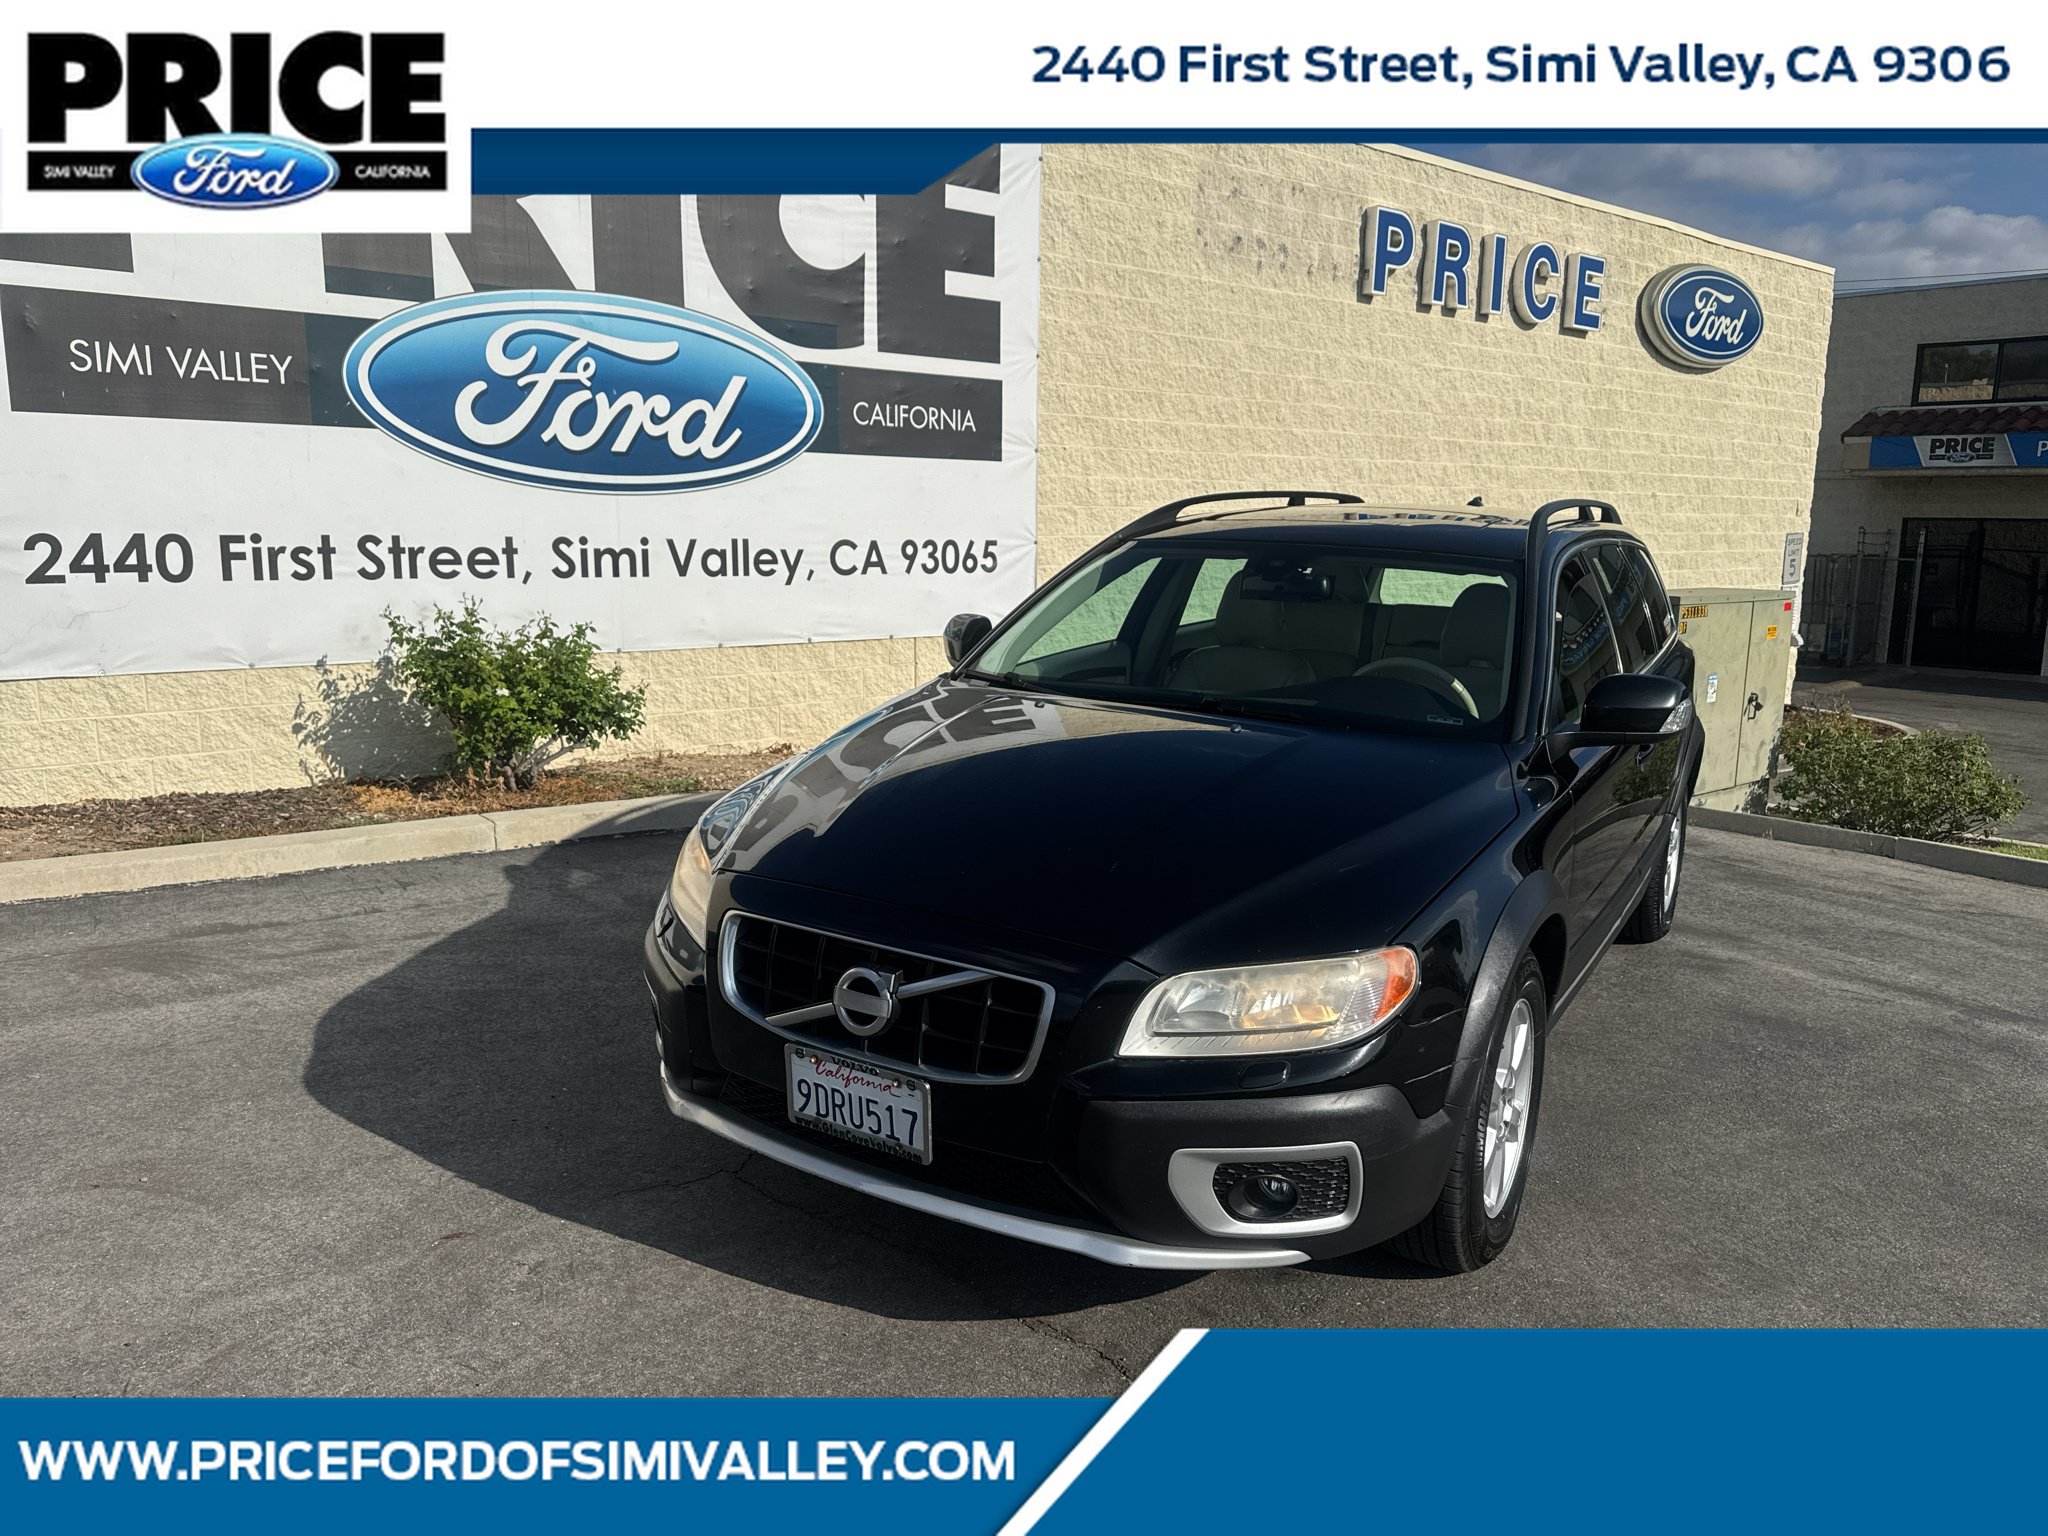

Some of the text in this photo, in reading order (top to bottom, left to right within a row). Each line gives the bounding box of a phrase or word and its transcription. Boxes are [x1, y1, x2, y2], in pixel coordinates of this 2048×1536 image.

[1364, 205, 1607, 332] PRICE
[1685, 286, 1748, 346] Ford
[68, 337, 293, 386] SIMI VALLEY
[455, 319, 748, 460] Ford
[852, 401, 977, 433] CALIFORNIA
[1930, 437, 1995, 454] PRICE
[23, 532, 998, 586] 2440 First Street, Simi Valley, CA 93065
[1789, 558, 1797, 578] 5
[815, 1060, 902, 1098] California
[831, 1056, 880, 1077] VOLVO
[797, 1078, 918, 1147] 9DRU517
